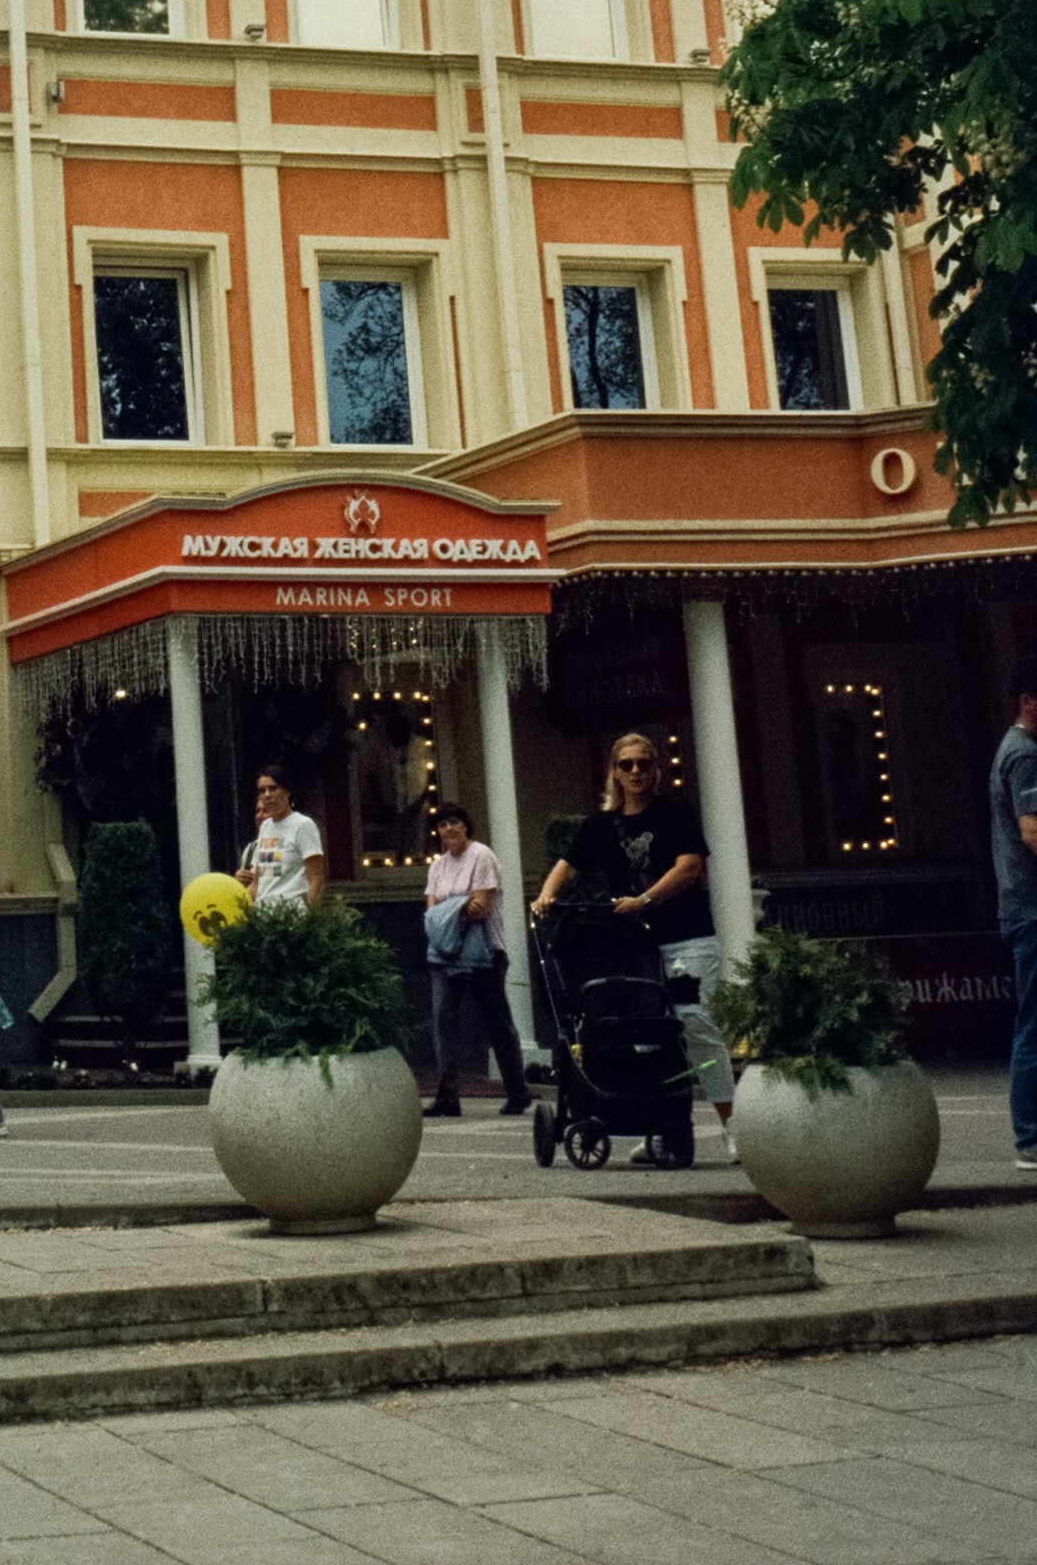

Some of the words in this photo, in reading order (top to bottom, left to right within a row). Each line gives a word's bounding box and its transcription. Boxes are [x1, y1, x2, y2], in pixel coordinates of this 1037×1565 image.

[181, 534, 309, 559] МУЖСКАЯ
[313, 536, 429, 560] ЖЕНСКАЯ
[432, 537, 542, 563] ОДЕЖДА
[274, 587, 371, 607] MARINA
[383, 587, 453, 608] SPORT
